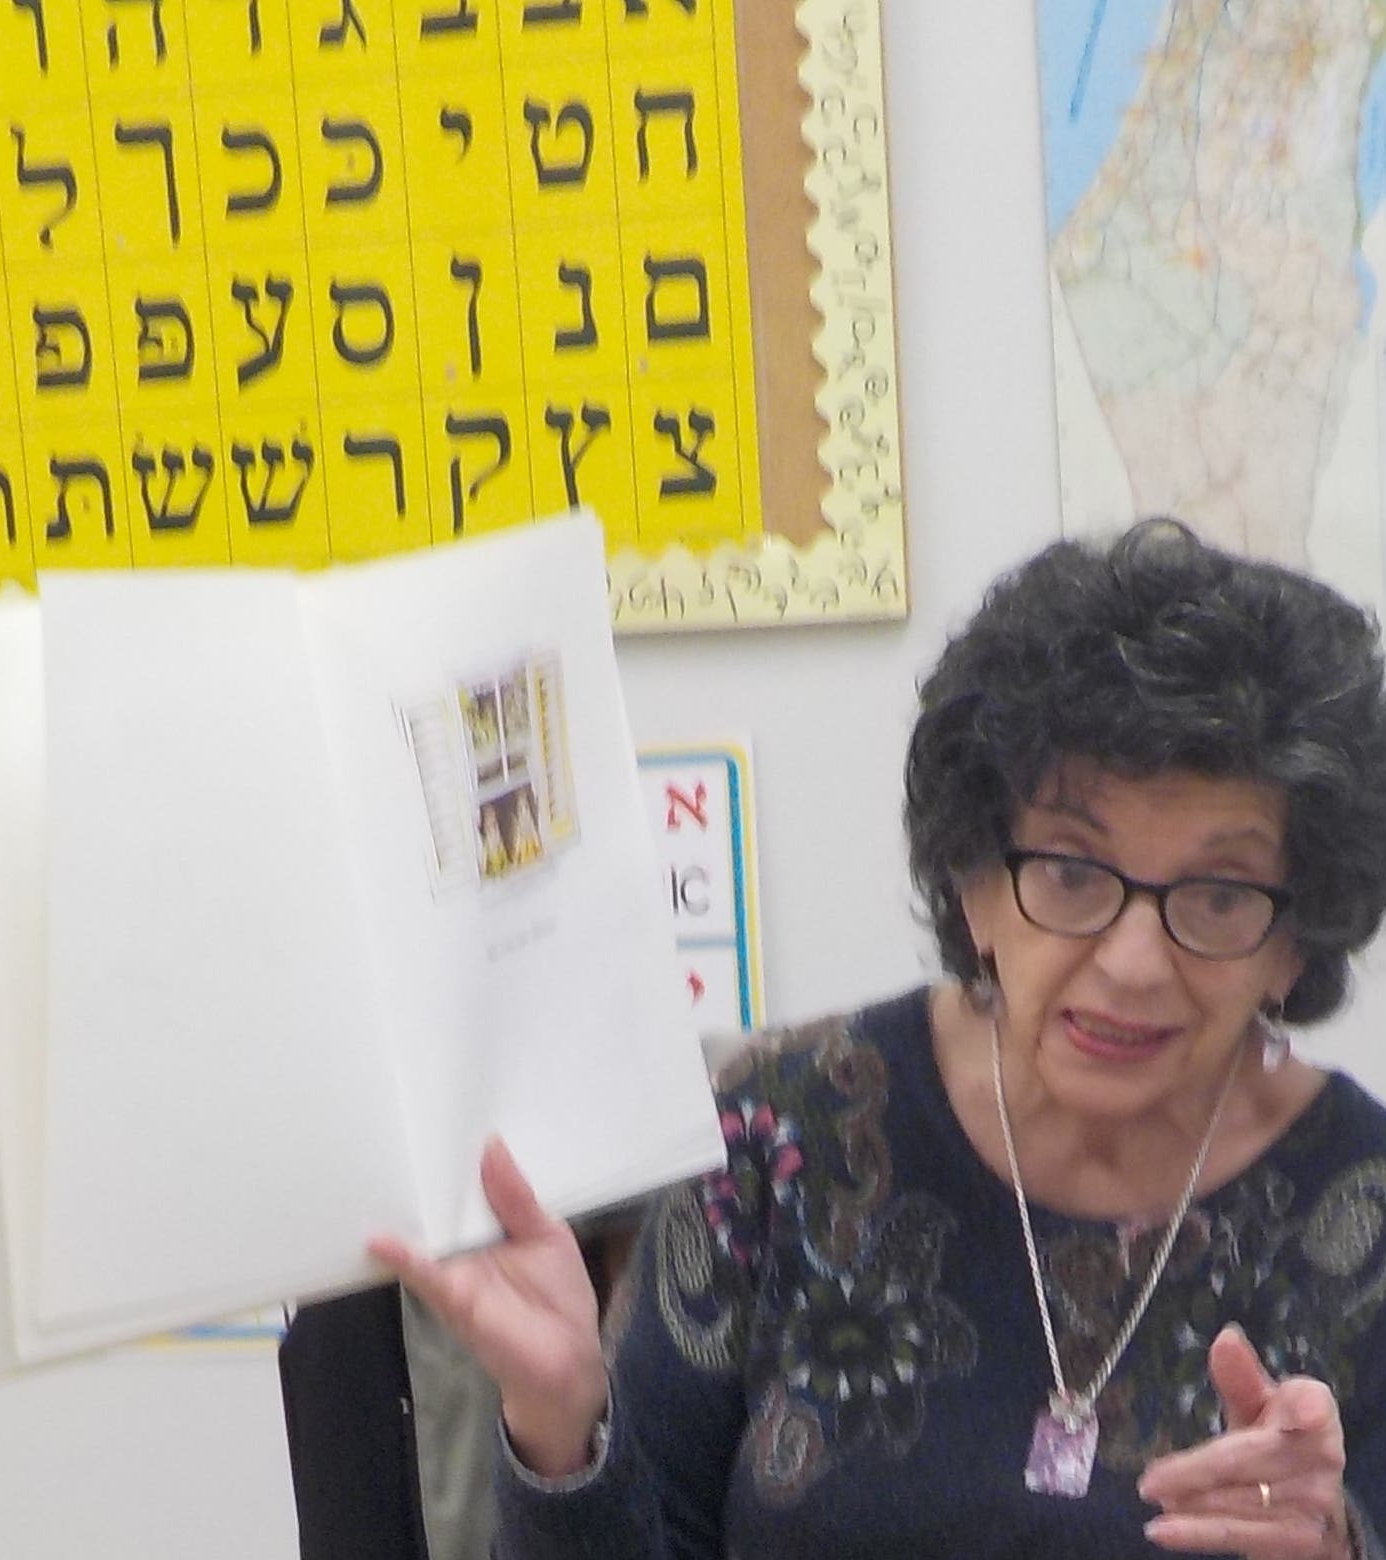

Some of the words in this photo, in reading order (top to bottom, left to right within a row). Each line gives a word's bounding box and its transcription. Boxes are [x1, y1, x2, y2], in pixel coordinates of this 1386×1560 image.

[439, 106, 474, 162] י
[523, 98, 595, 192] ט
[633, 86, 699, 182] ח
[9, 126, 79, 249] ל
[114, 121, 183, 245] ך
[230, 272, 294, 388] ע
[328, 278, 397, 368] ס
[553, 261, 599, 351] נ
[643, 250, 712, 343] ם
[342, 430, 407, 520] ר
[444, 410, 514, 536] ק
[544, 402, 613, 513] ץ
[651, 408, 719, 500] צ
